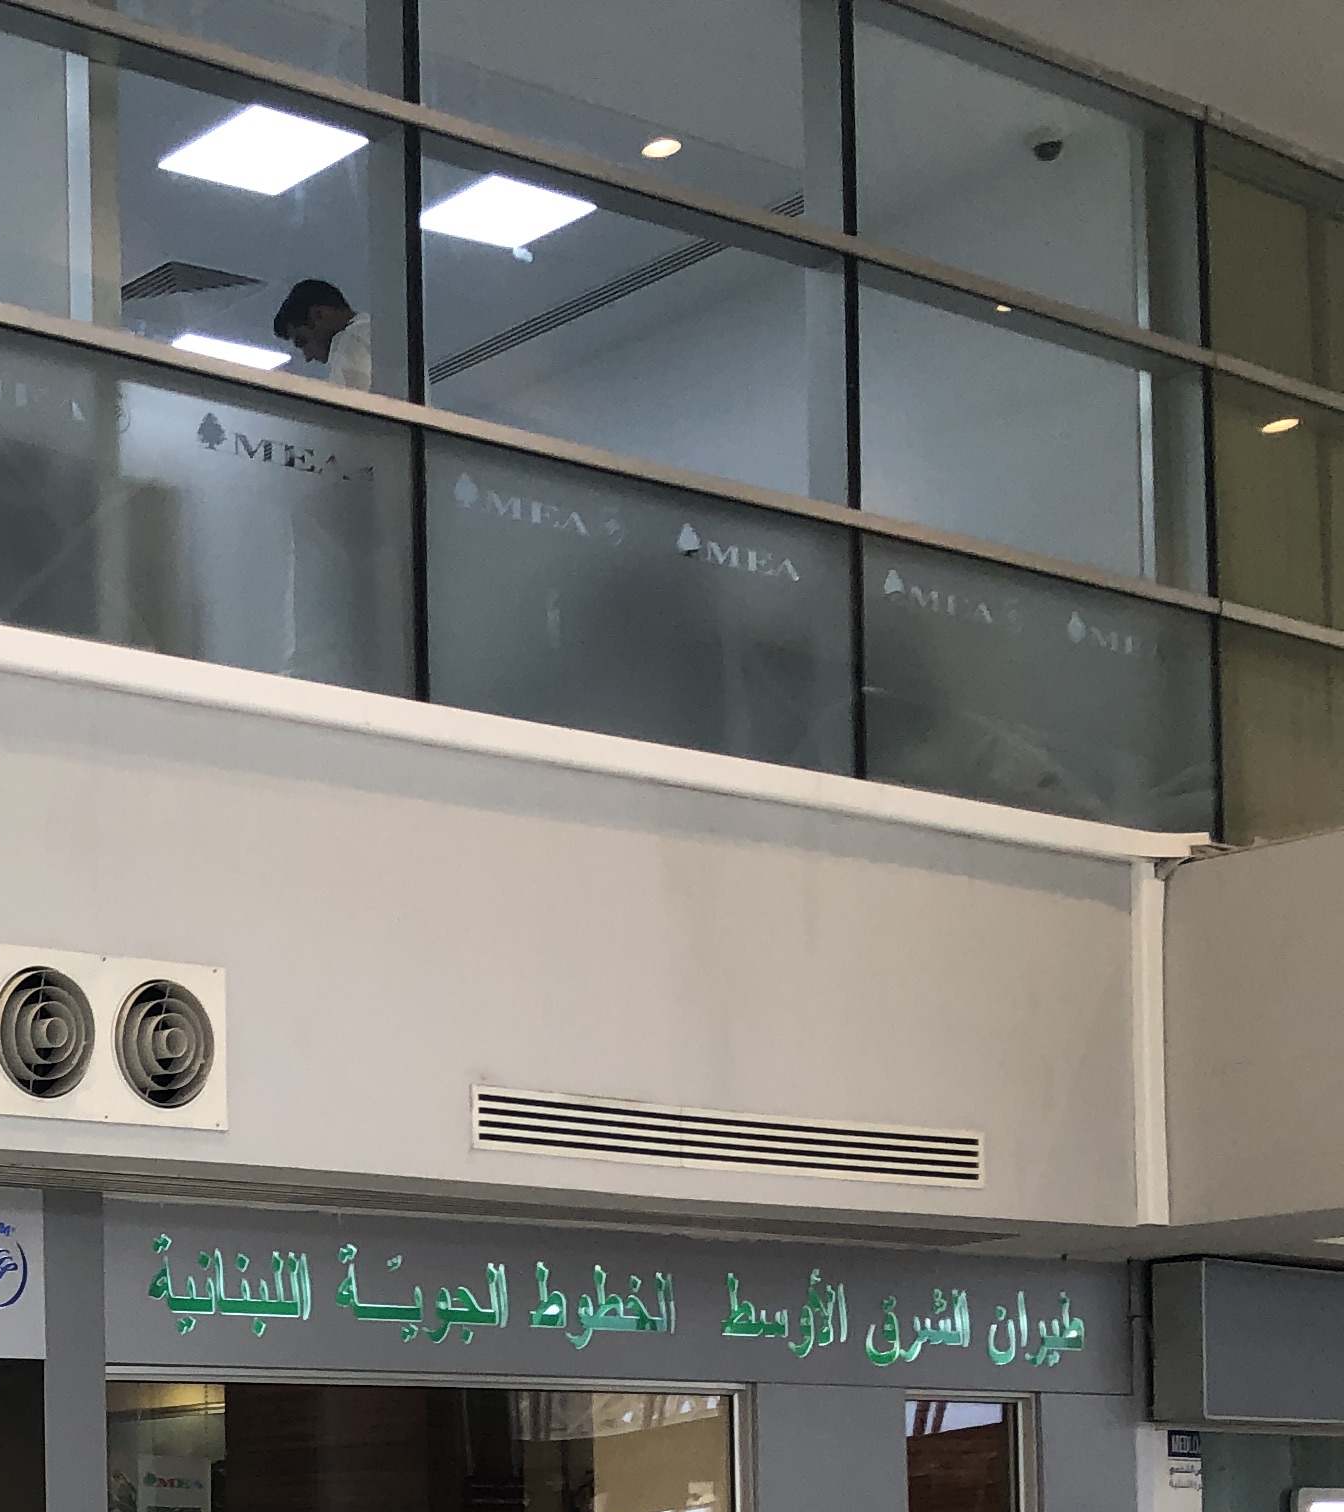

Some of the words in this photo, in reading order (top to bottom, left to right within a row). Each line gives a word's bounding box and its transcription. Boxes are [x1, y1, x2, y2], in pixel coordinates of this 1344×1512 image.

[706, 540, 800, 582] MEA
[148, 1233, 310, 1338] اللبنانية
[529, 1261, 676, 1349] الخطوط
[721, 1268, 848, 1358] الأوسط
[865, 1288, 971, 1367] الشرق
[988, 1290, 1085, 1367] طيران
